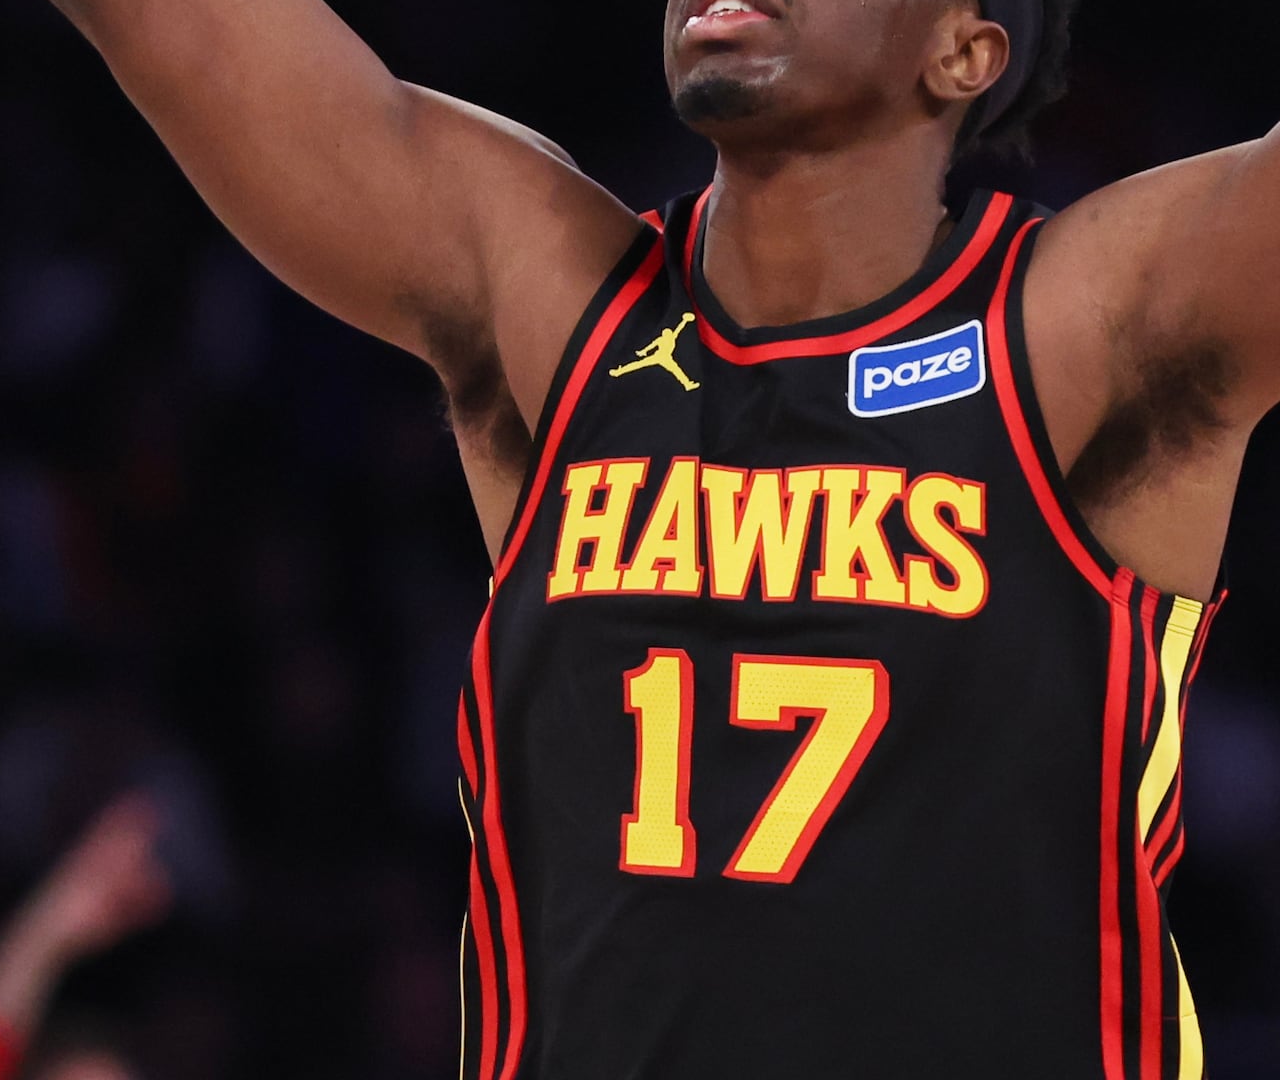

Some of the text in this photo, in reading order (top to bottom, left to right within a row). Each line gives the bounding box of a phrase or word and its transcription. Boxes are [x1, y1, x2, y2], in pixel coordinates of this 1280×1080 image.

[863, 346, 972, 399] paze
[547, 456, 989, 619] HAWKS
[620, 648, 889, 884] 17
